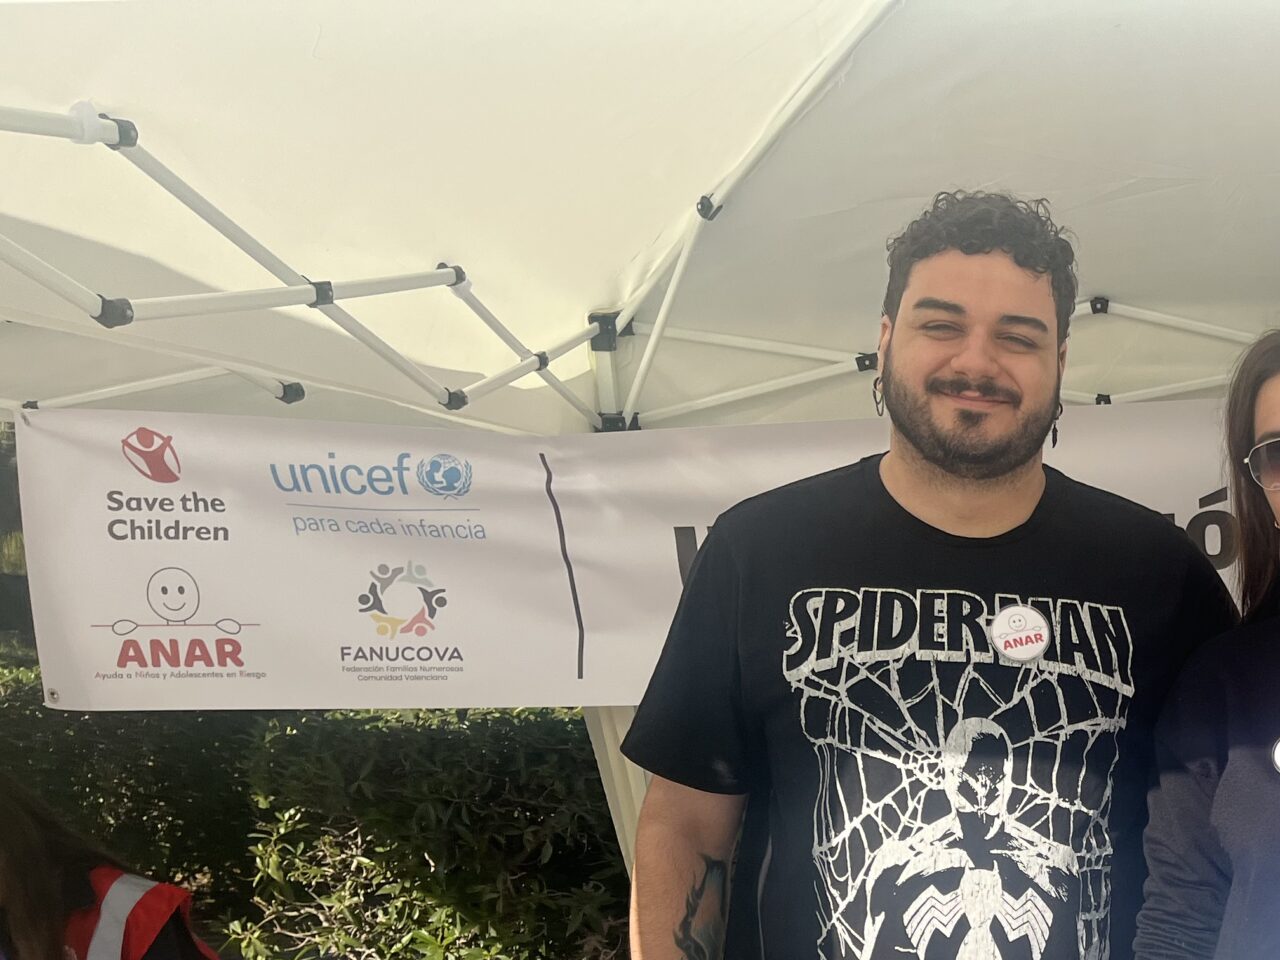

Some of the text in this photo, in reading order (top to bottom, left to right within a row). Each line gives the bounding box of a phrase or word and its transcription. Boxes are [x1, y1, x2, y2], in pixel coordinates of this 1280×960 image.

[270, 452, 411, 496] unicef
[107, 491, 226, 513] Save the
[107, 519, 229, 541] Children
[292, 512, 486, 540] para cada infancia
[117, 638, 244, 668] ANAR
[1003, 633, 1044, 651] ANAR
[340, 646, 464, 661] FANUCOVA
[94, 672, 123, 680] Ayuda
[135, 671, 160, 679] Niños
[170, 671, 223, 679] Adolescentes
[240, 671, 267, 680] Riesgo
